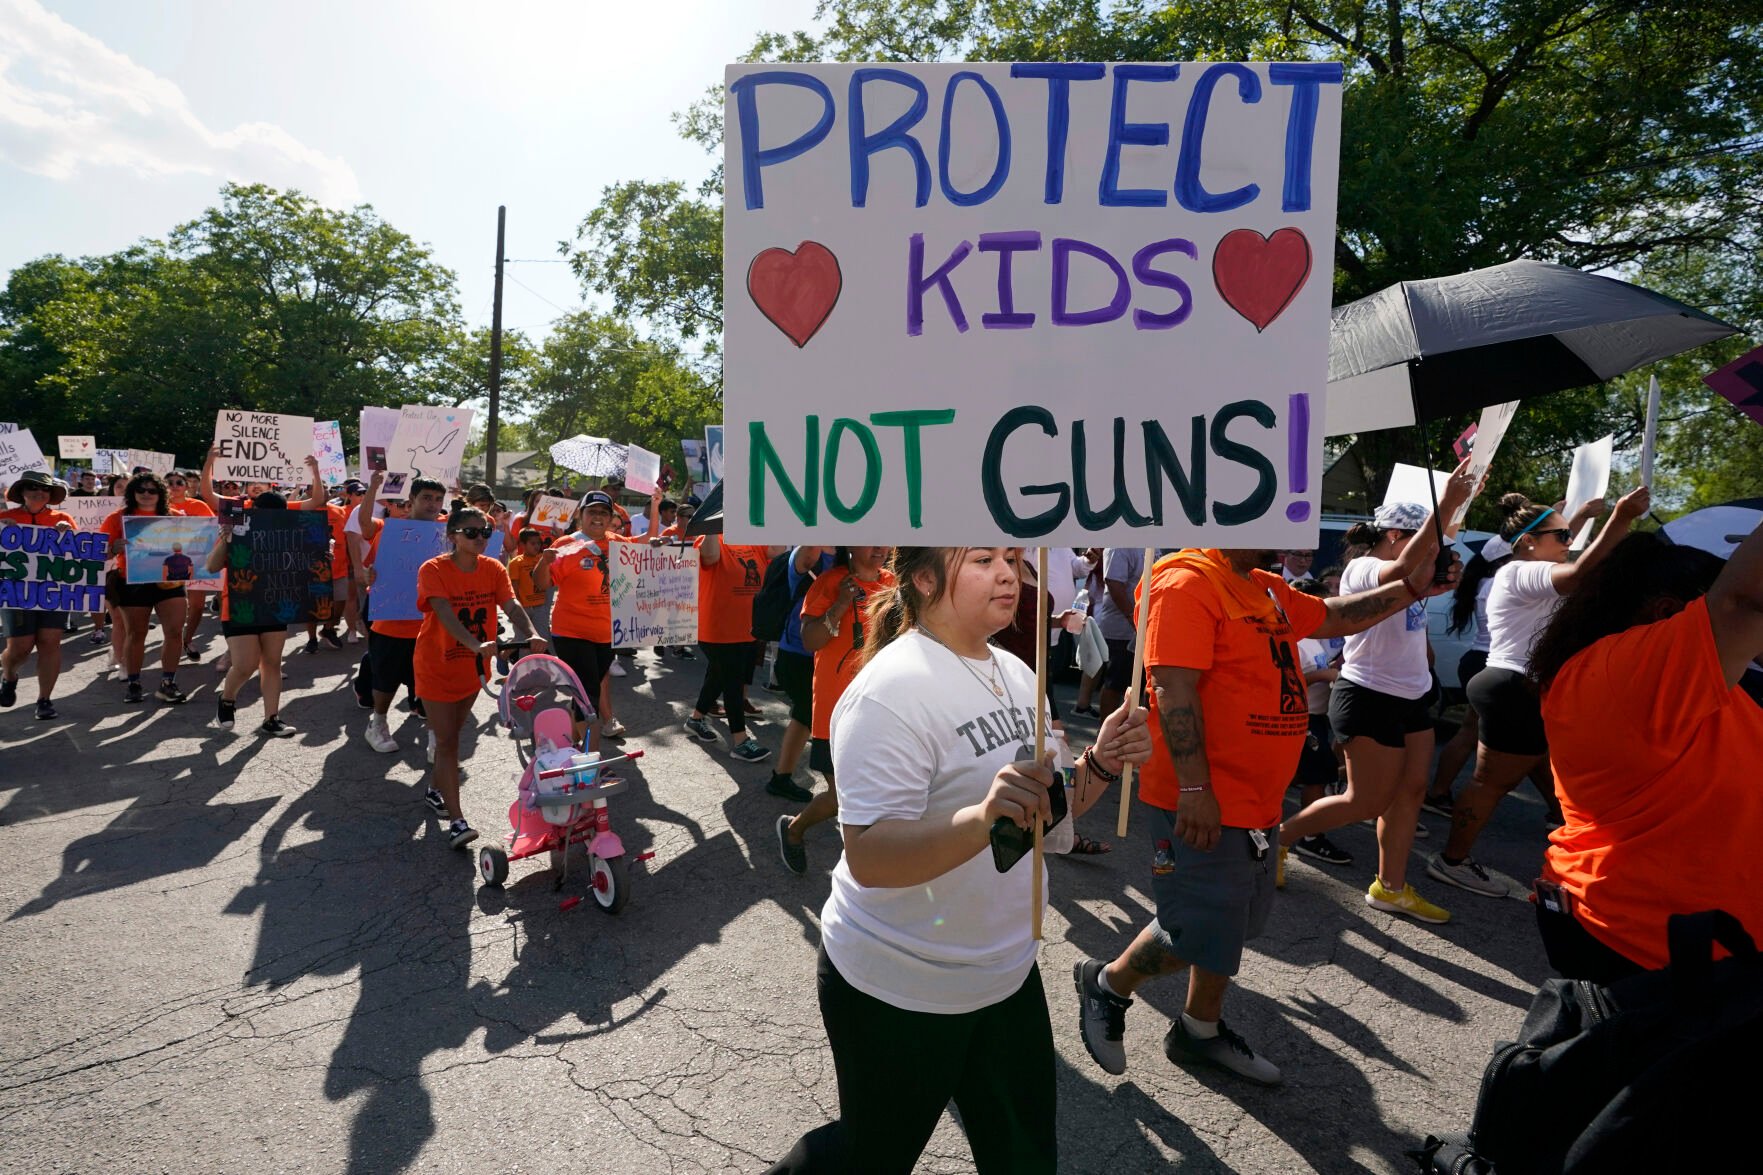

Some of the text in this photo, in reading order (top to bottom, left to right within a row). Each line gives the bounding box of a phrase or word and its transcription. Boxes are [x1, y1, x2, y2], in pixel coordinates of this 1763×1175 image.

[731, 62, 1343, 212] PROTECT
[906, 230, 1197, 336] KIDS
[226, 412, 279, 426] NO MORE
[231, 424, 280, 440] SILENCE
[218, 439, 291, 465] END GUN
[748, 393, 1310, 538] NOT GUNS!
[78, 500, 116, 510] MARCH
[252, 528, 304, 552] PROTECT
[36, 555, 105, 585] NOT
[619, 545, 697, 578] Say their Names
[267, 572, 298, 590] NOT
[636, 578, 645, 589] 21
[613, 618, 629, 646] Be
